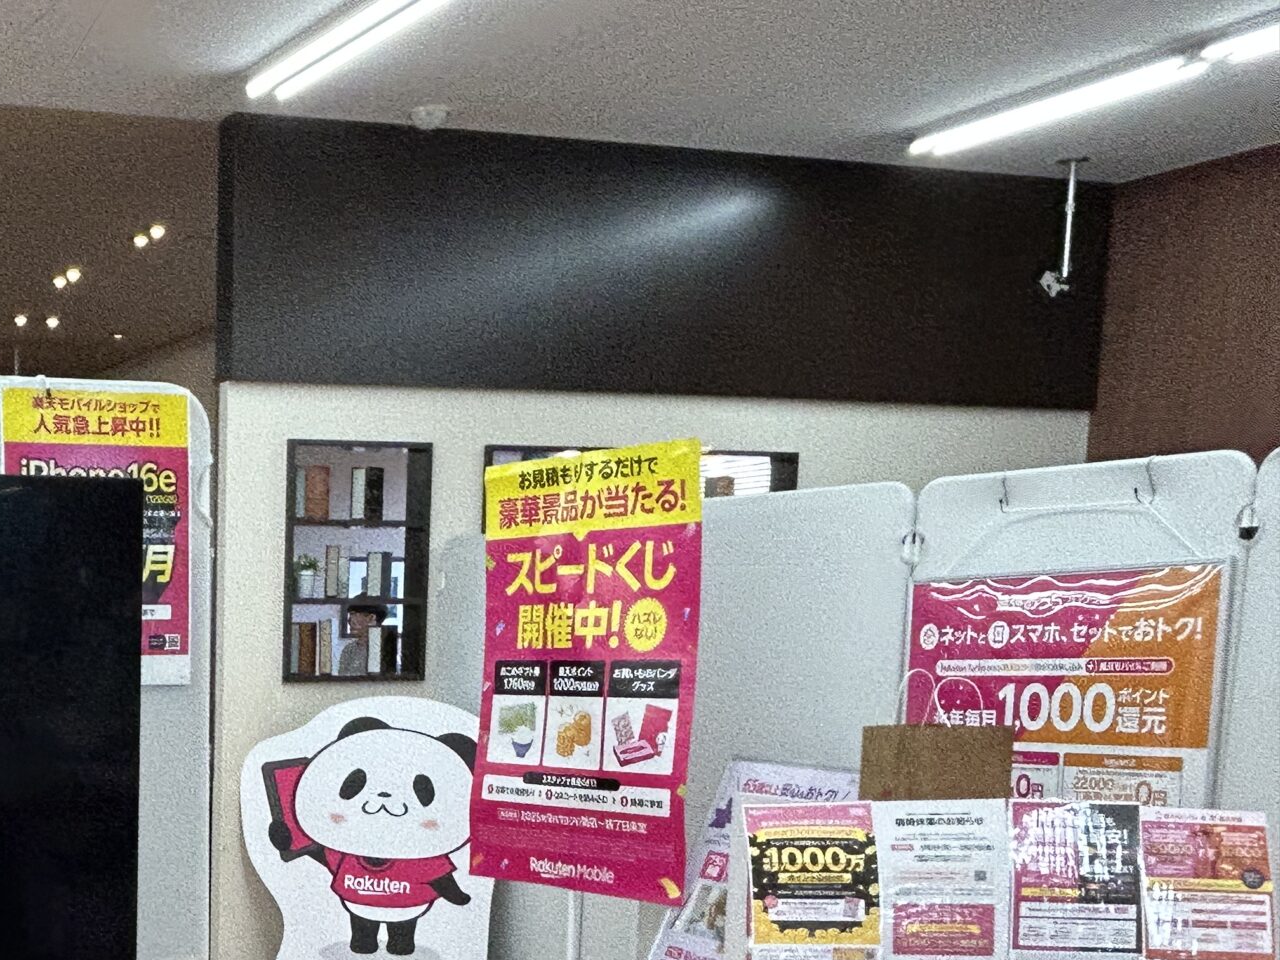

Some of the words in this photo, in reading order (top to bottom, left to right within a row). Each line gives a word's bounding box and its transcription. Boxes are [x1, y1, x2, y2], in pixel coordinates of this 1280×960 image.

[33, 413, 161, 438] 人気急上昇中!!
[518, 455, 659, 491] お見積もりするだけで
[498, 478, 687, 530] 豪華景品が当たる!
[505, 539, 677, 597] スピードくじ
[516, 600, 623, 650] 開催中!
[998, 682, 1116, 734] 1,000
[1117, 687, 1170, 706] ポイント
[1115, 706, 1168, 735] 還元
[343, 875, 411, 896] Rakuten
[529, 856, 576, 879] Rakuten
[577, 862, 615, 884] Mobile
